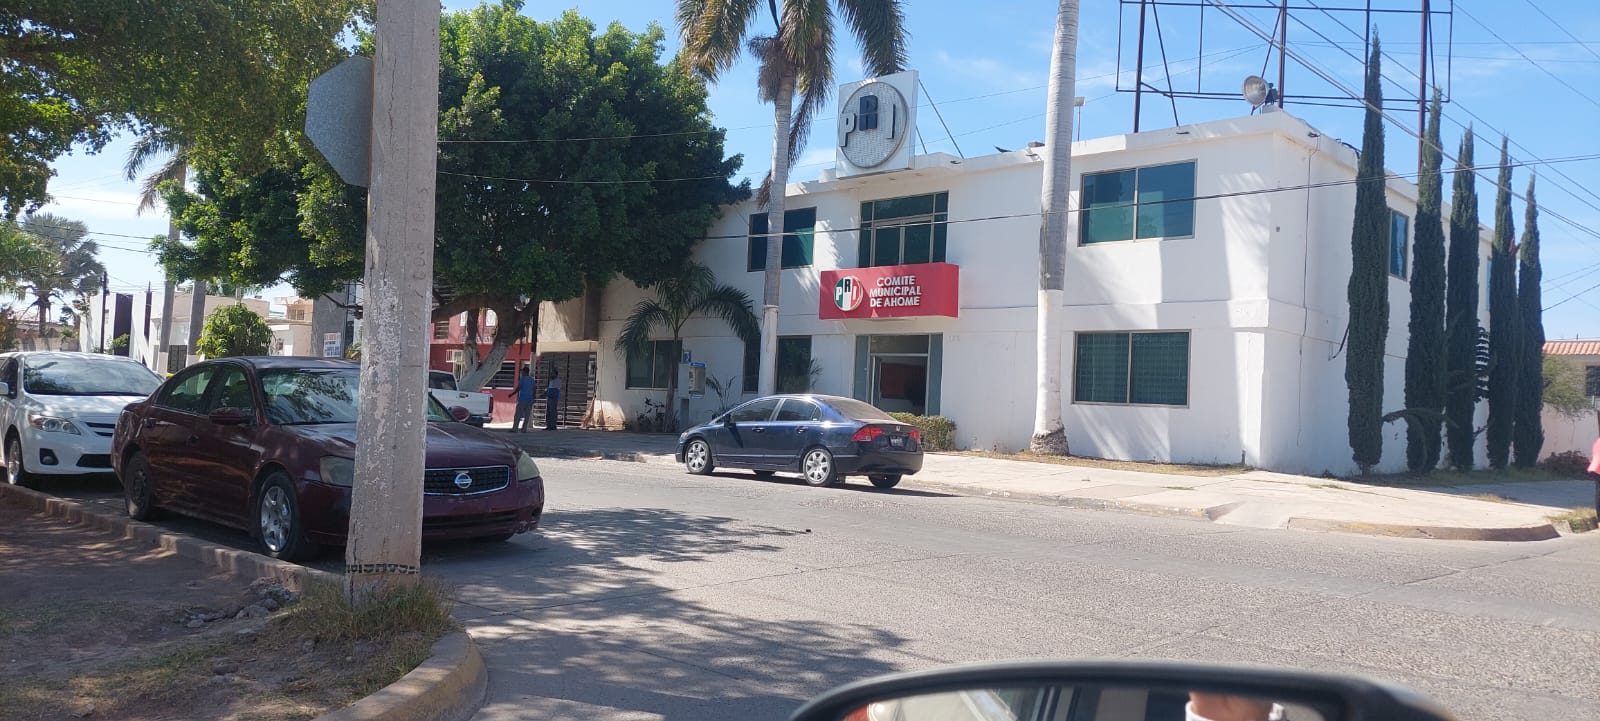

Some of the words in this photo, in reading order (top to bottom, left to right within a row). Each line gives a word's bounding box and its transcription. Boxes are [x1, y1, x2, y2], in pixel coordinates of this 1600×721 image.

[838, 95, 896, 147] PRI
[876, 275, 915, 287] COMITE
[835, 279, 857, 301] PRI
[869, 285, 922, 298] MUNICIPAL
[870, 298, 883, 308] DE
[883, 296, 920, 307] AHOME
